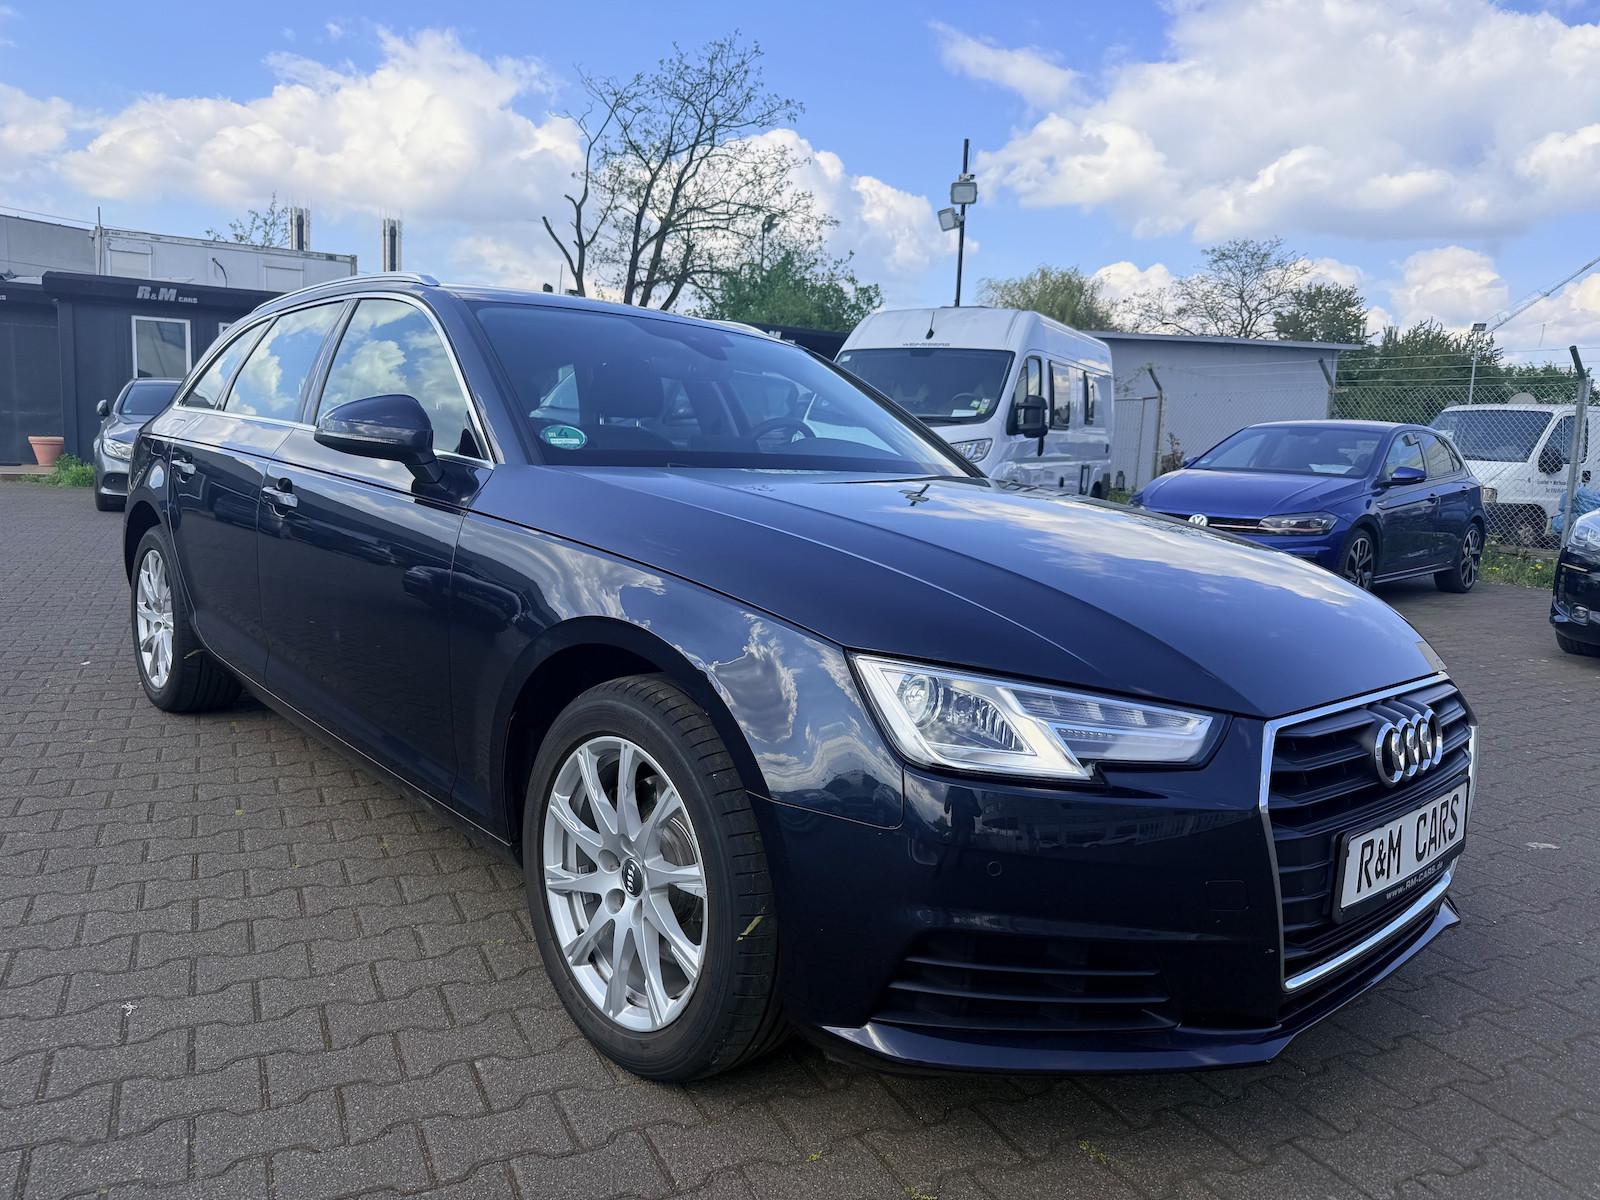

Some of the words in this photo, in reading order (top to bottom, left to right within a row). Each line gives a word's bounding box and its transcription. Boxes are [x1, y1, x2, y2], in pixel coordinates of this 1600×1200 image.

[136, 285, 177, 302] R&M
[1356, 824, 1402, 894] R&M
[1415, 793, 1459, 862] CARS
